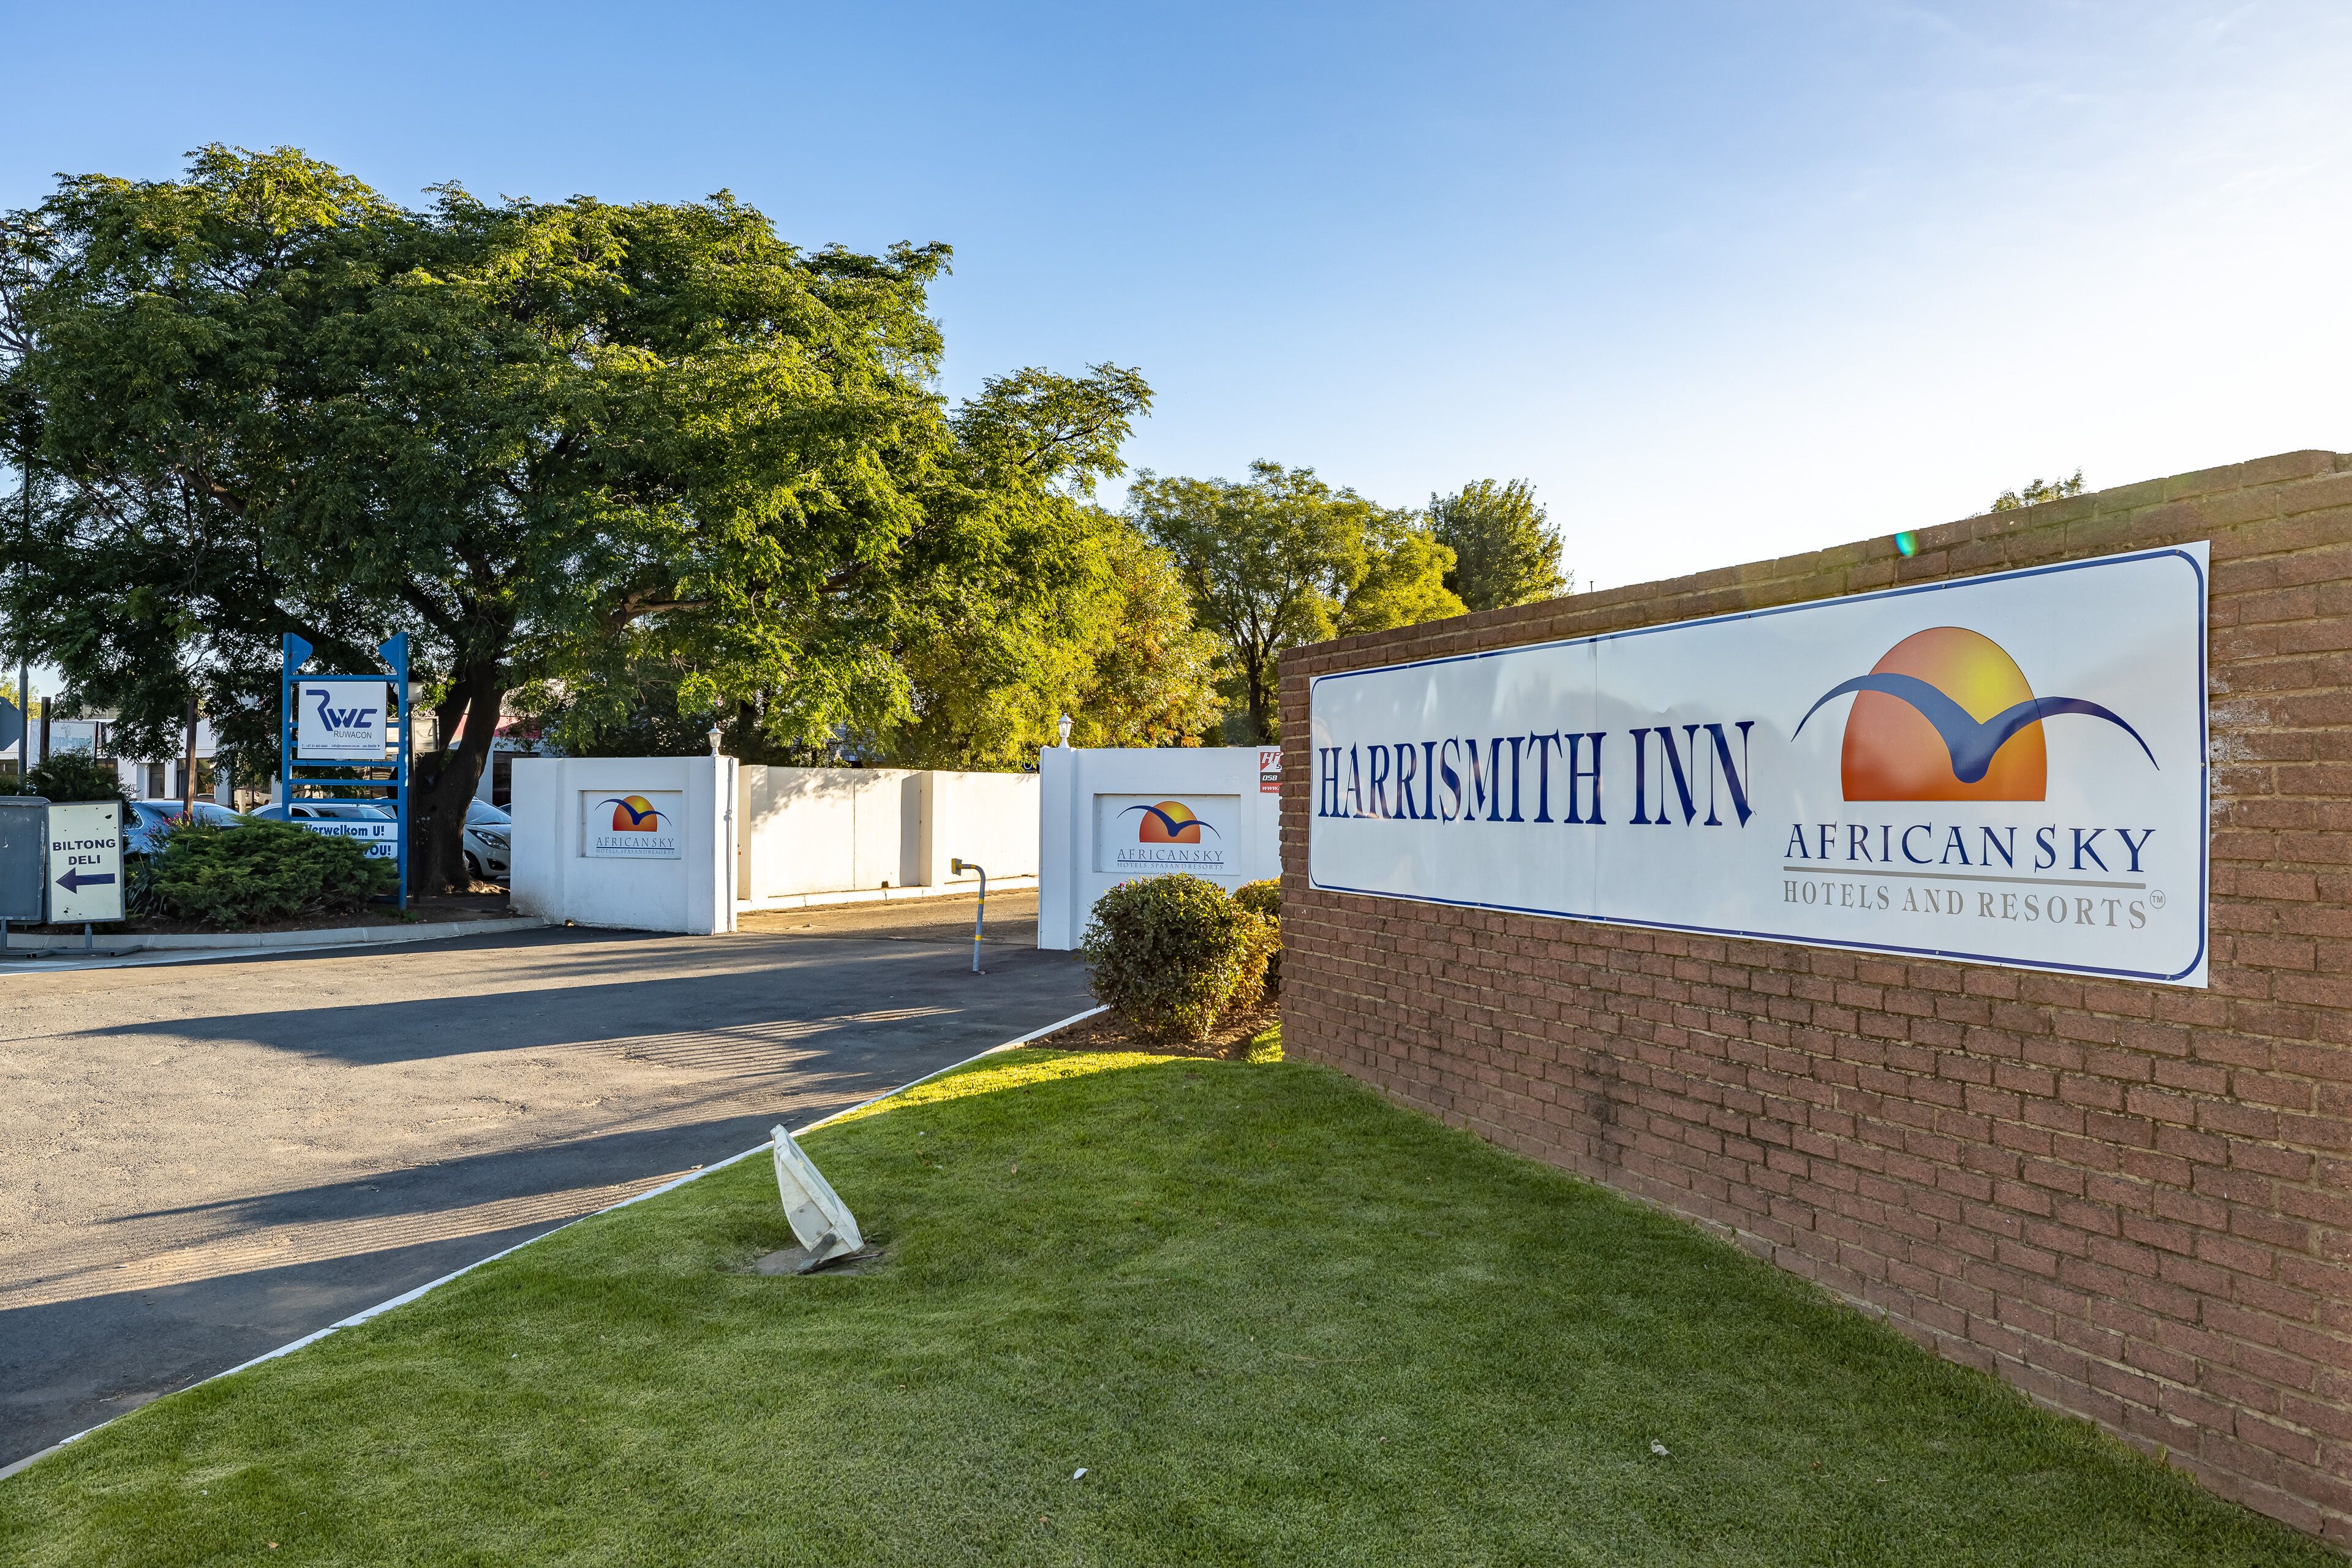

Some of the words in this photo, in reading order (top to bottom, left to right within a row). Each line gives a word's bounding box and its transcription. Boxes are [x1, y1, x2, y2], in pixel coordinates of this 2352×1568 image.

[306, 690, 377, 731] RWC
[334, 730, 372, 739] RUWACON
[1318, 728, 1607, 826] HARRISMITH
[1629, 721, 1755, 829] INN
[373, 826, 385, 837] U!
[53, 839, 116, 851] BILTONG
[69, 854, 100, 865] DELI
[1784, 880, 1890, 911] HOTELS
[1902, 888, 1964, 914] AND
[1978, 892, 2146, 929] RESORTS
